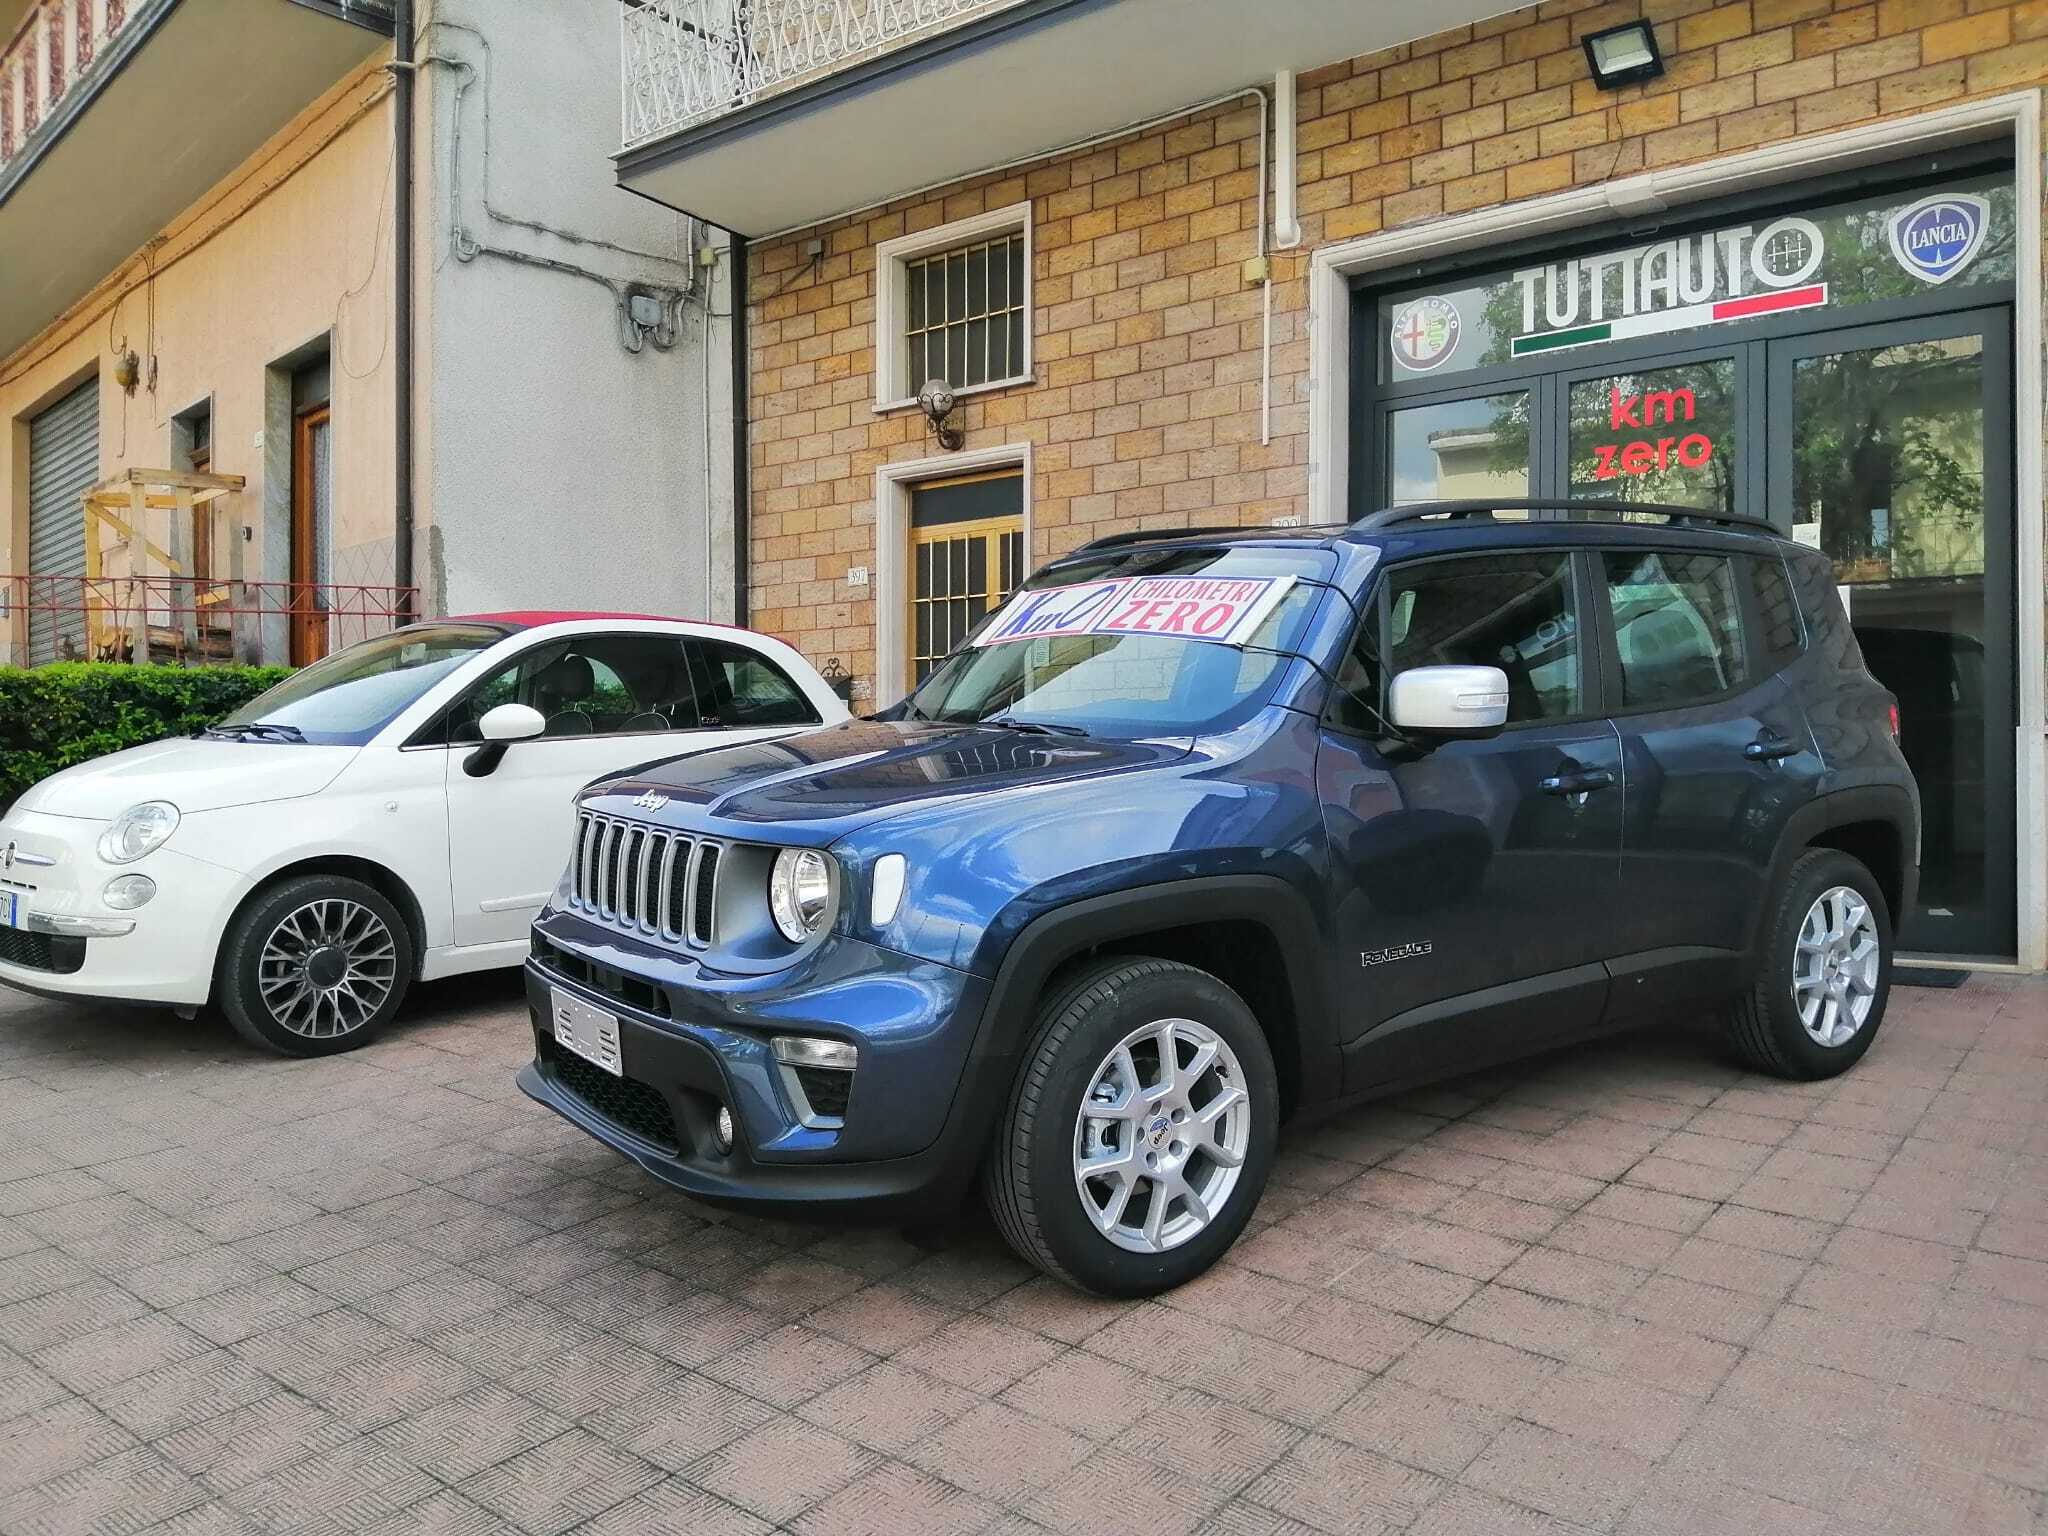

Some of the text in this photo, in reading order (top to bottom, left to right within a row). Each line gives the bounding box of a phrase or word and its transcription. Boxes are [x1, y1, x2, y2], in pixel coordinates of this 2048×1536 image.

[1911, 222, 1967, 250] LANCIA
[1513, 217, 1824, 333] TUTTAUTO
[1611, 387, 1696, 431] km
[1594, 432, 1713, 480] zero
[1132, 580, 1262, 602] CHILOMETRI
[1106, 600, 1234, 635] ZERO
[633, 788, 669, 813] Jeep
[1360, 940, 1432, 967] RENEGADE
[1153, 1120, 1169, 1145] Jeep
